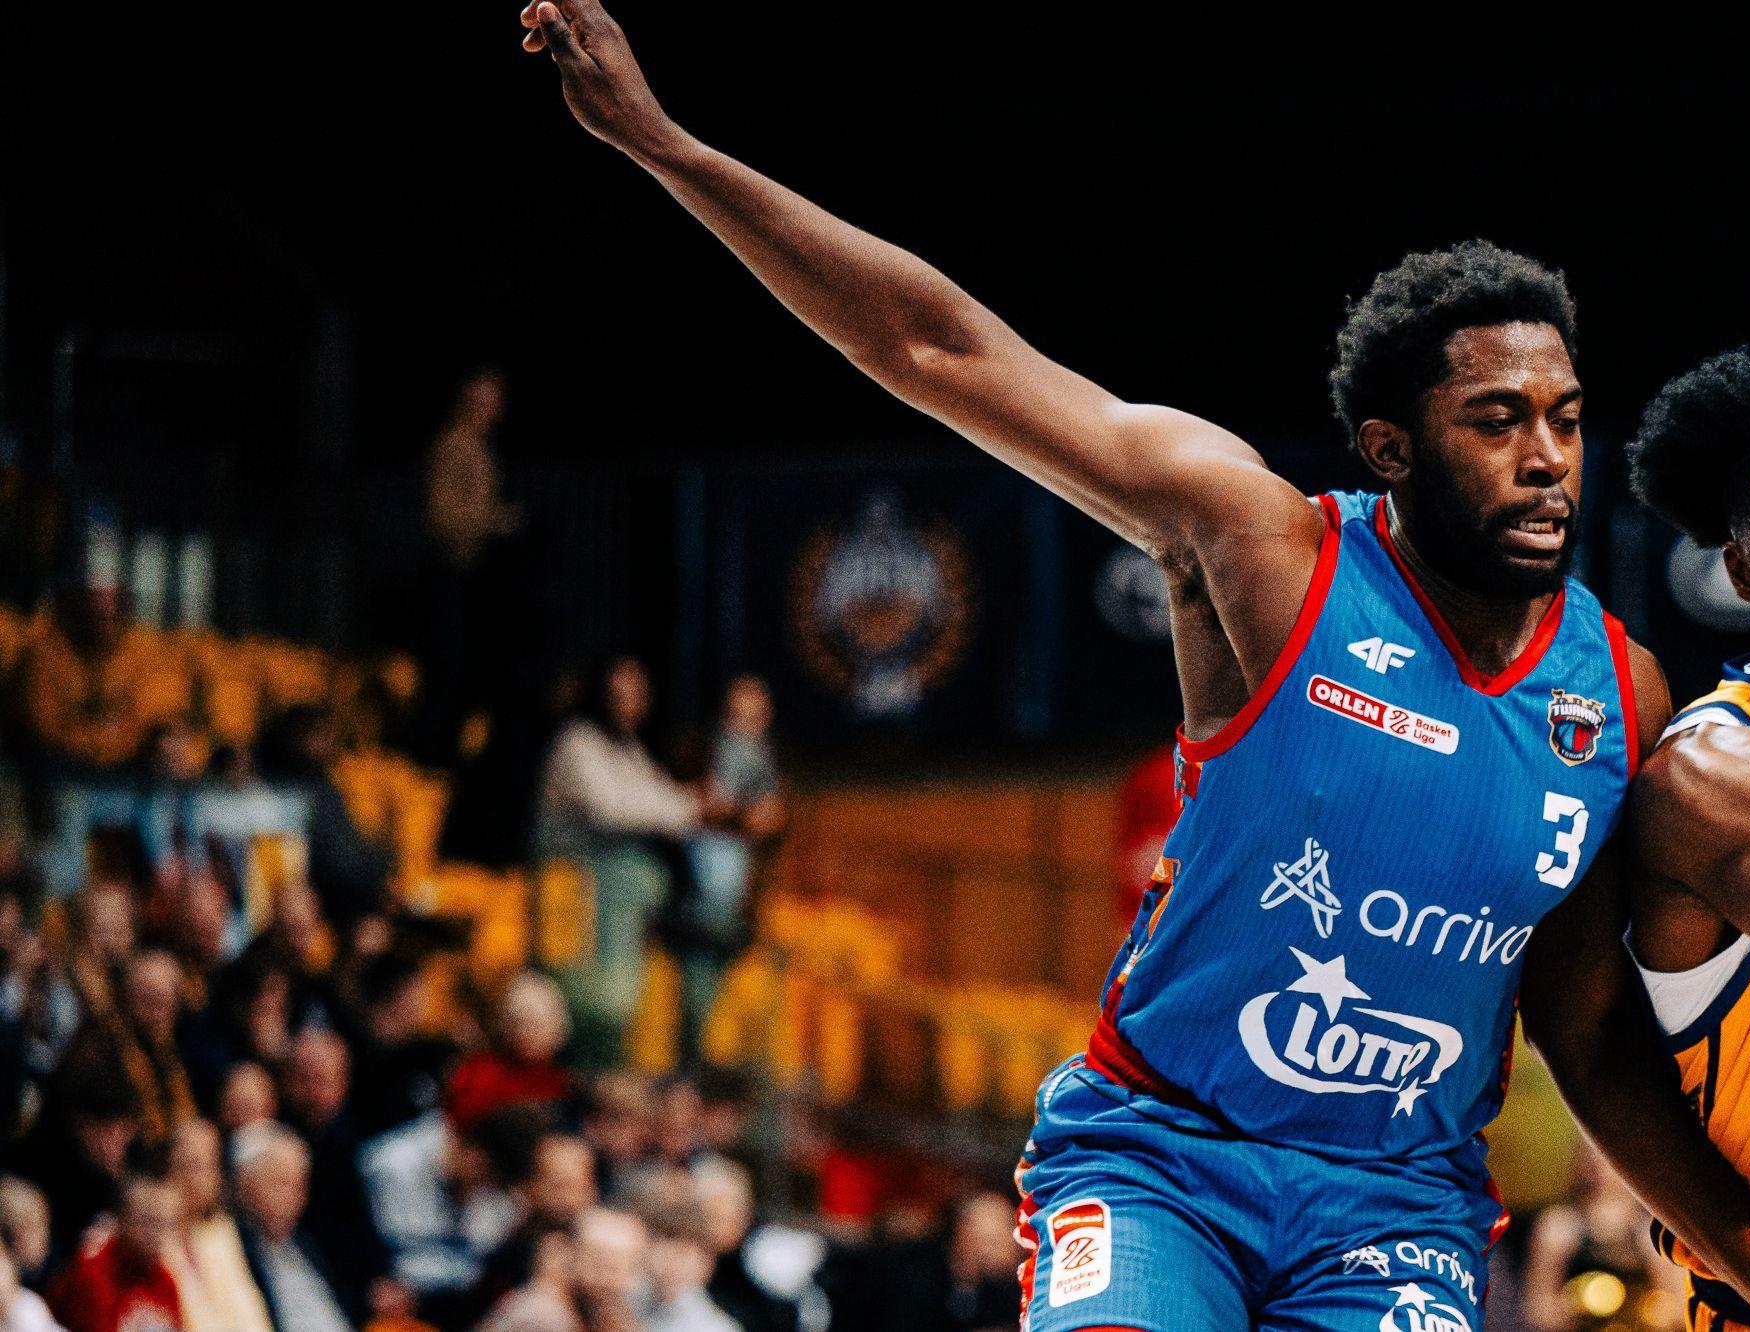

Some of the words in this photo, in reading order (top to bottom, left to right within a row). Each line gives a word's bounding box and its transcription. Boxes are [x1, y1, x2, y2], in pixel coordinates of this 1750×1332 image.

[1347, 637, 1417, 675] 4F
[1315, 683, 1380, 722] ORLEN
[1413, 729, 1436, 744] Liga
[1415, 718, 1452, 738] Basket
[1534, 791, 1590, 889] 3
[1284, 1002, 1431, 1081] LOTTO
